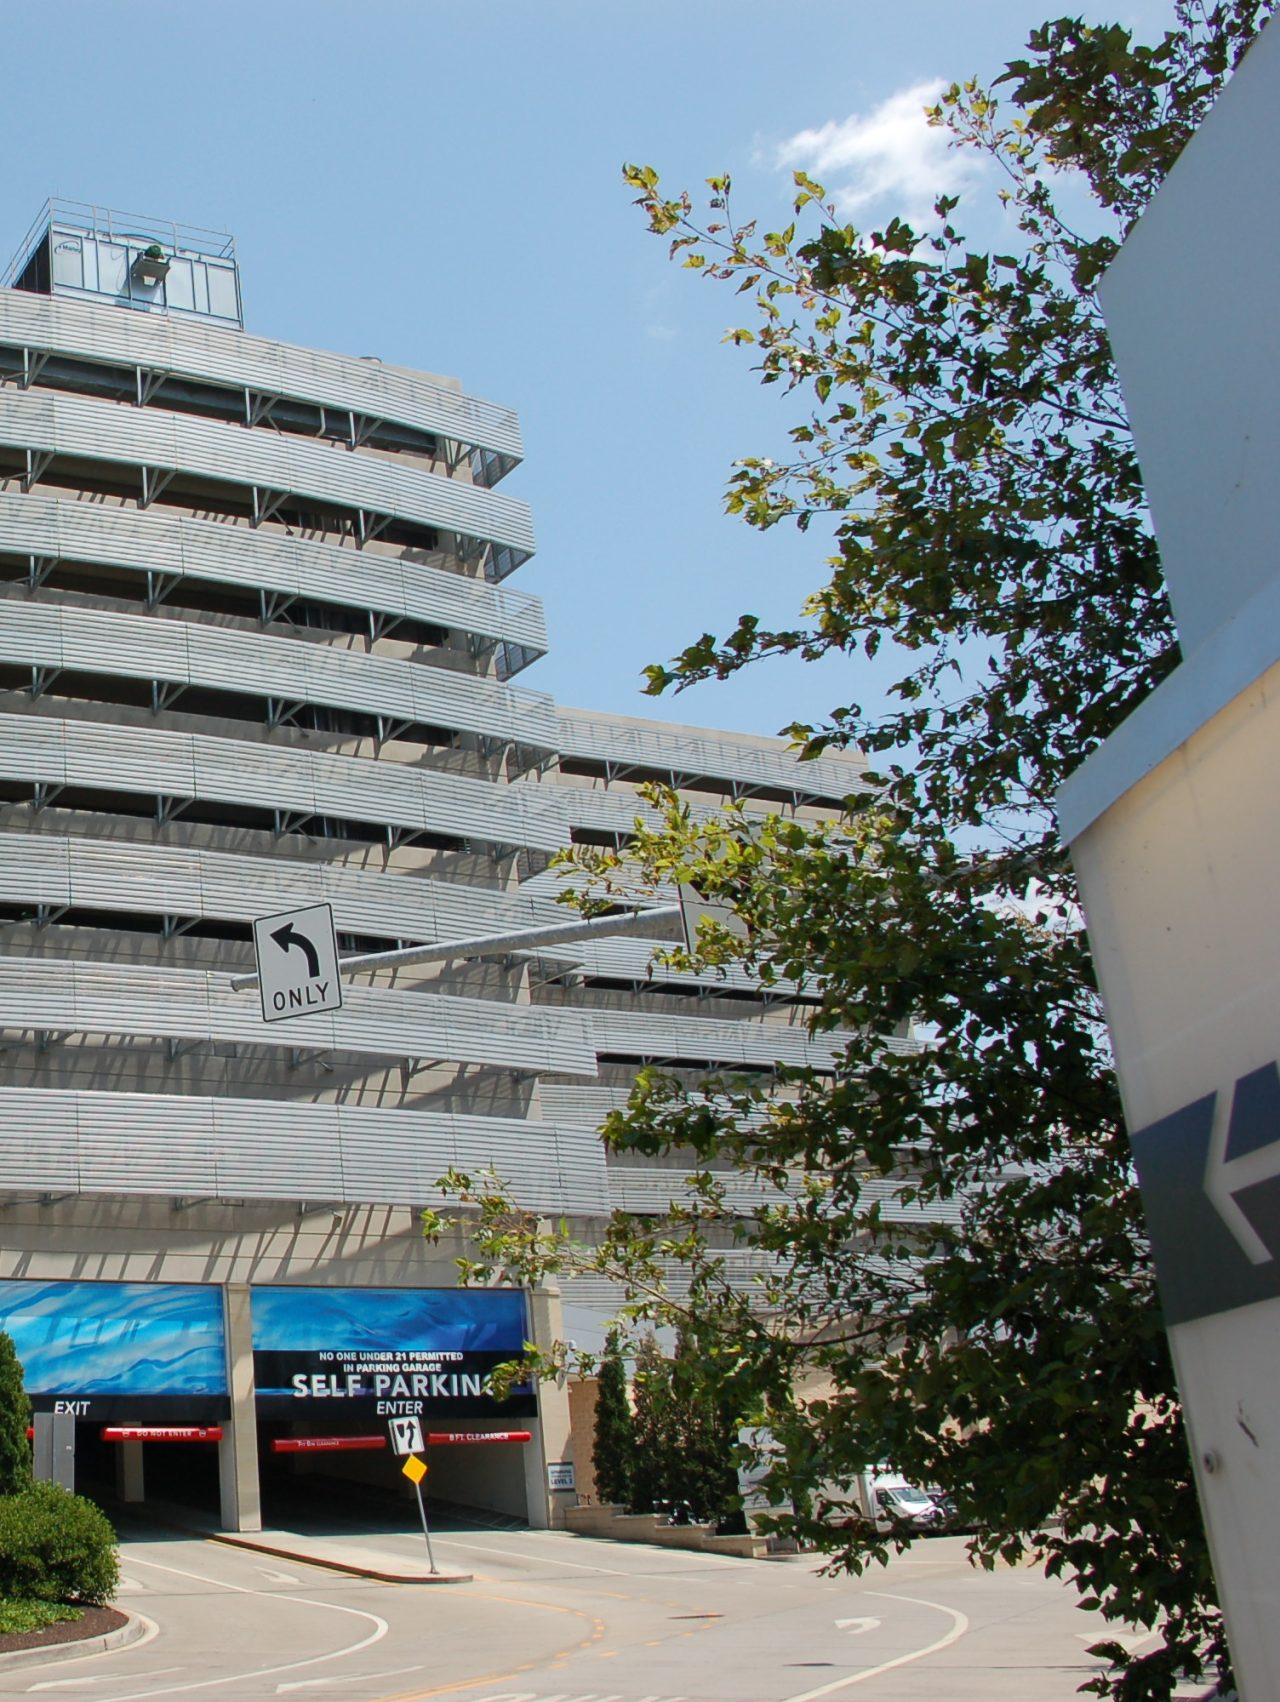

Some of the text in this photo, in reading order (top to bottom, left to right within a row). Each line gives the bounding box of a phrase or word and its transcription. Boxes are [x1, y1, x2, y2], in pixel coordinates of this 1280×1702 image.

[273, 982, 329, 1011] ONLY
[320, 1352, 463, 1361] NO ONE UNDER 21 PERMITTED
[343, 1363, 442, 1372] IN PARKING GARAGE
[292, 1374, 361, 1397] SELF
[54, 1401, 90, 1415] EXIT
[376, 1401, 423, 1415] ENTER
